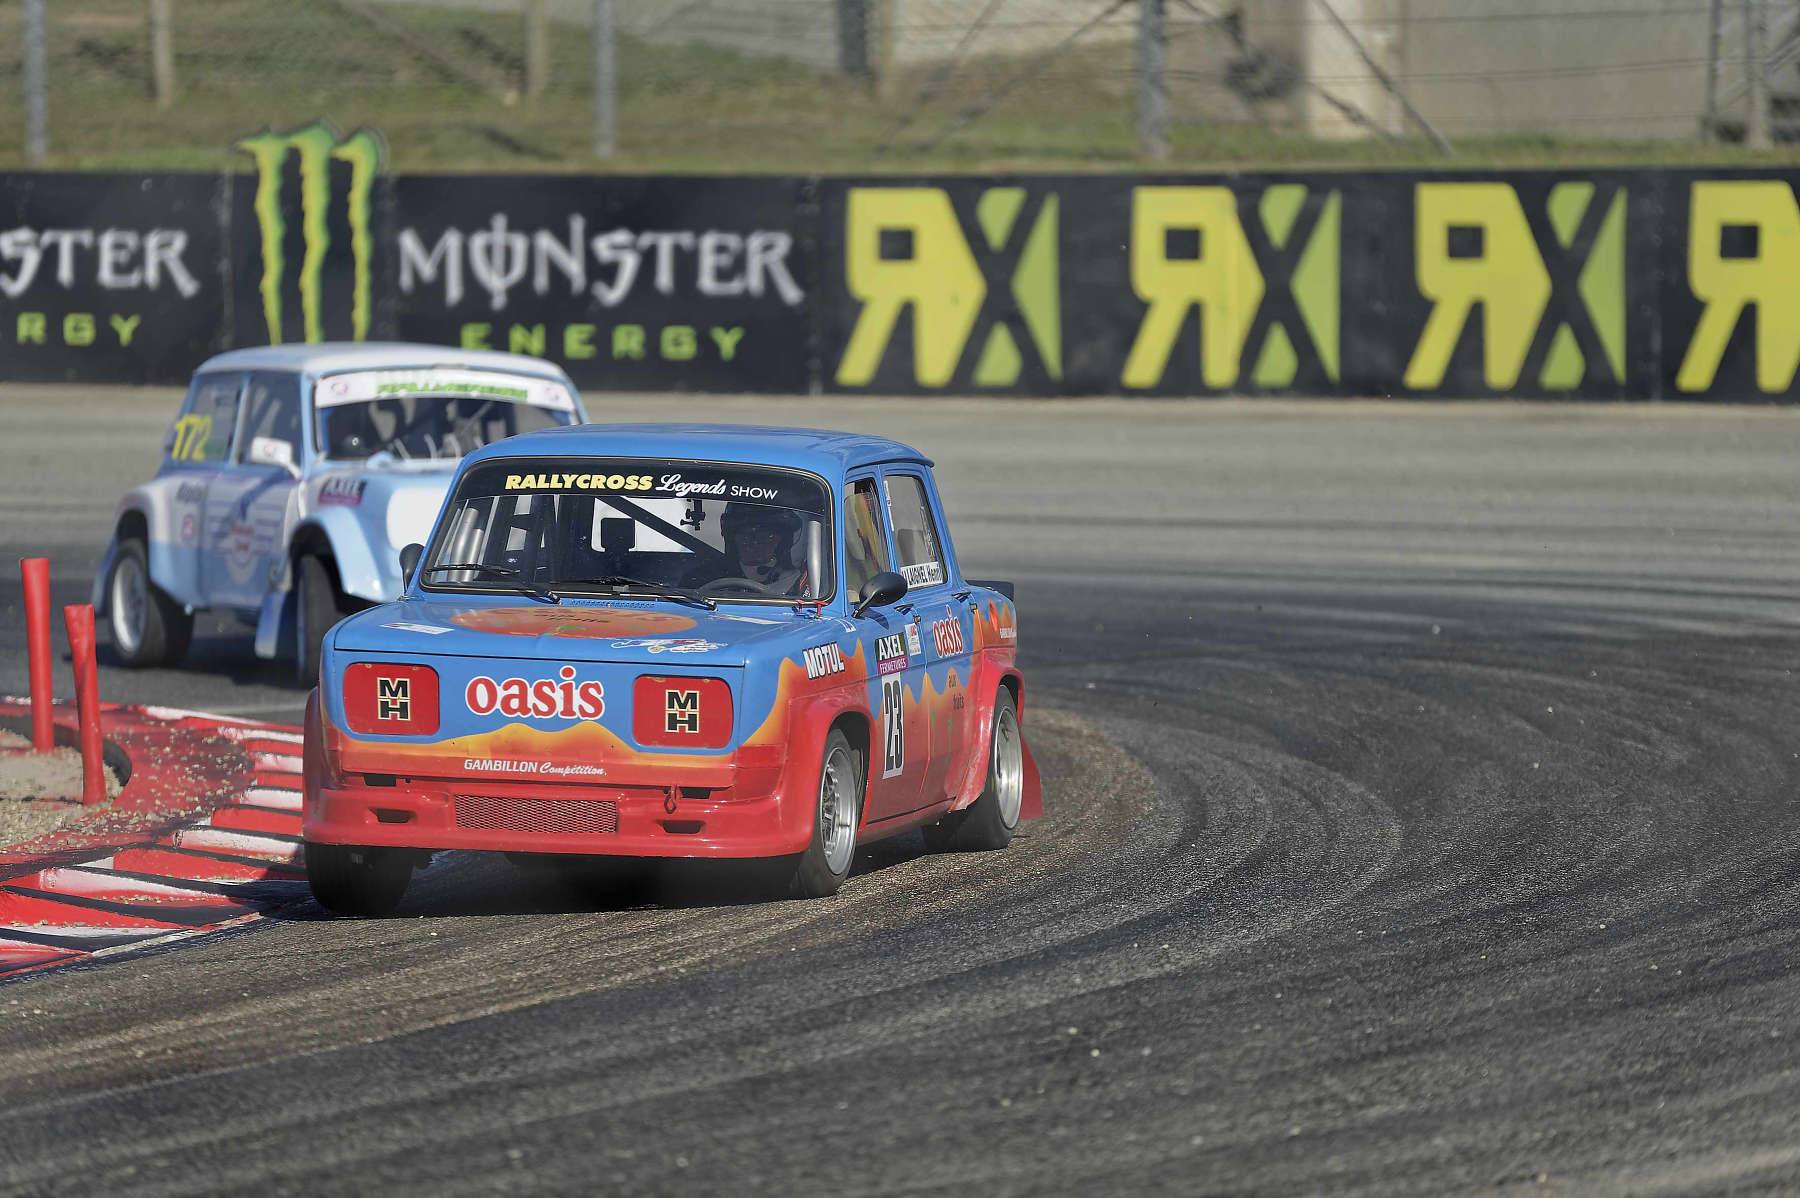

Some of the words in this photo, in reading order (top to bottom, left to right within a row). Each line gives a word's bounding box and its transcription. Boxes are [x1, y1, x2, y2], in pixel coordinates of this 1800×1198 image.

[397, 212, 805, 311] MONSTER
[460, 322, 745, 361] ENERGY
[171, 413, 212, 462] 172
[505, 474, 653, 491] RALLYCROSS
[655, 473, 727, 497] Legends
[730, 485, 778, 500] SHOW
[878, 634, 904, 661] AXEL
[932, 605, 964, 658] oasis
[802, 641, 845, 680] MOTUL
[465, 665, 604, 720] oasis
[884, 680, 903, 771] 23
[464, 759, 538, 773] GAMBILLON
